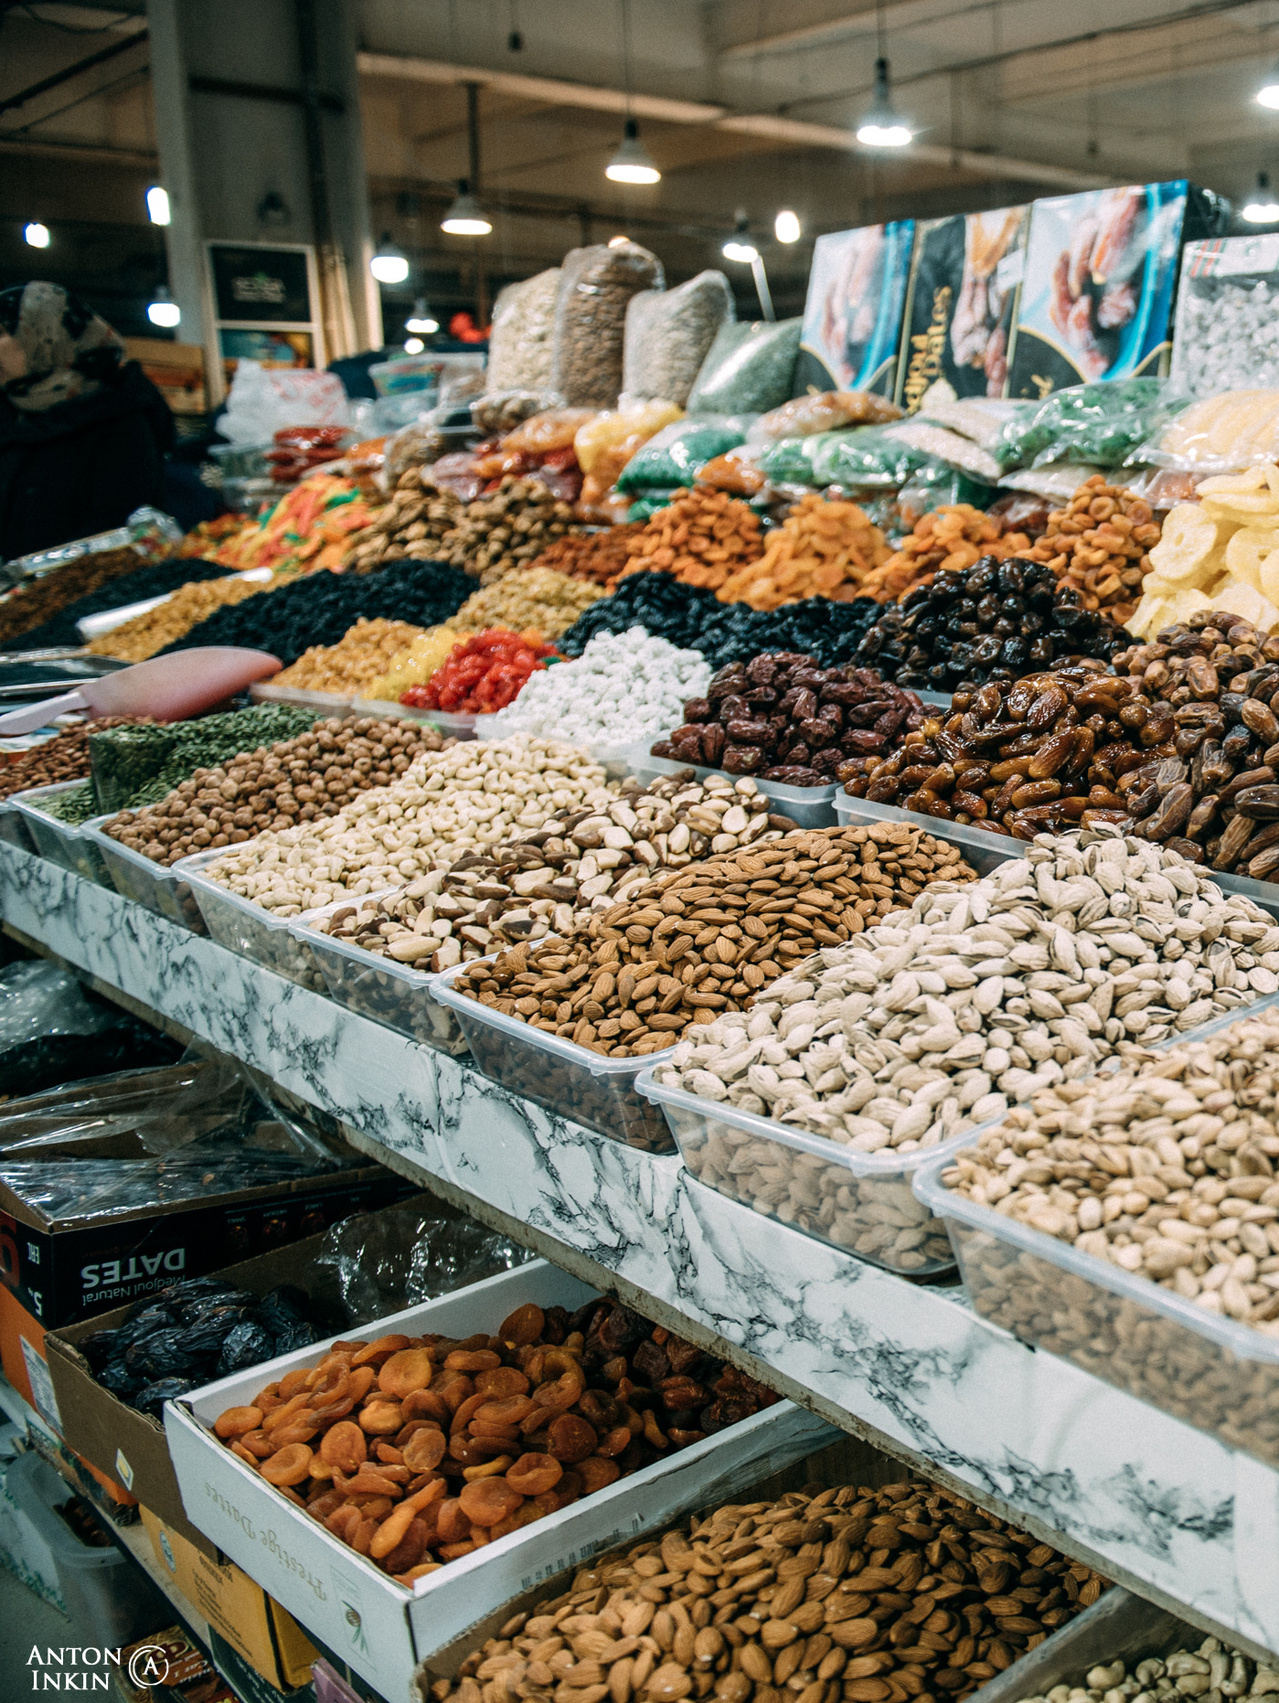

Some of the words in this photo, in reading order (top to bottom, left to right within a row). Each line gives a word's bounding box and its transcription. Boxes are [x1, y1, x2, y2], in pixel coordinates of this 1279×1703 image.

[924, 286, 952, 378] Dates
[81, 1248, 185, 1289] DATES
[134, 1274, 186, 1296] Medjoul
[34, 1291, 42, 1317] 5
[82, 1286, 131, 1307] Natural
[205, 1482, 256, 1539] Dattes
[259, 1529, 326, 1601] Prestige
